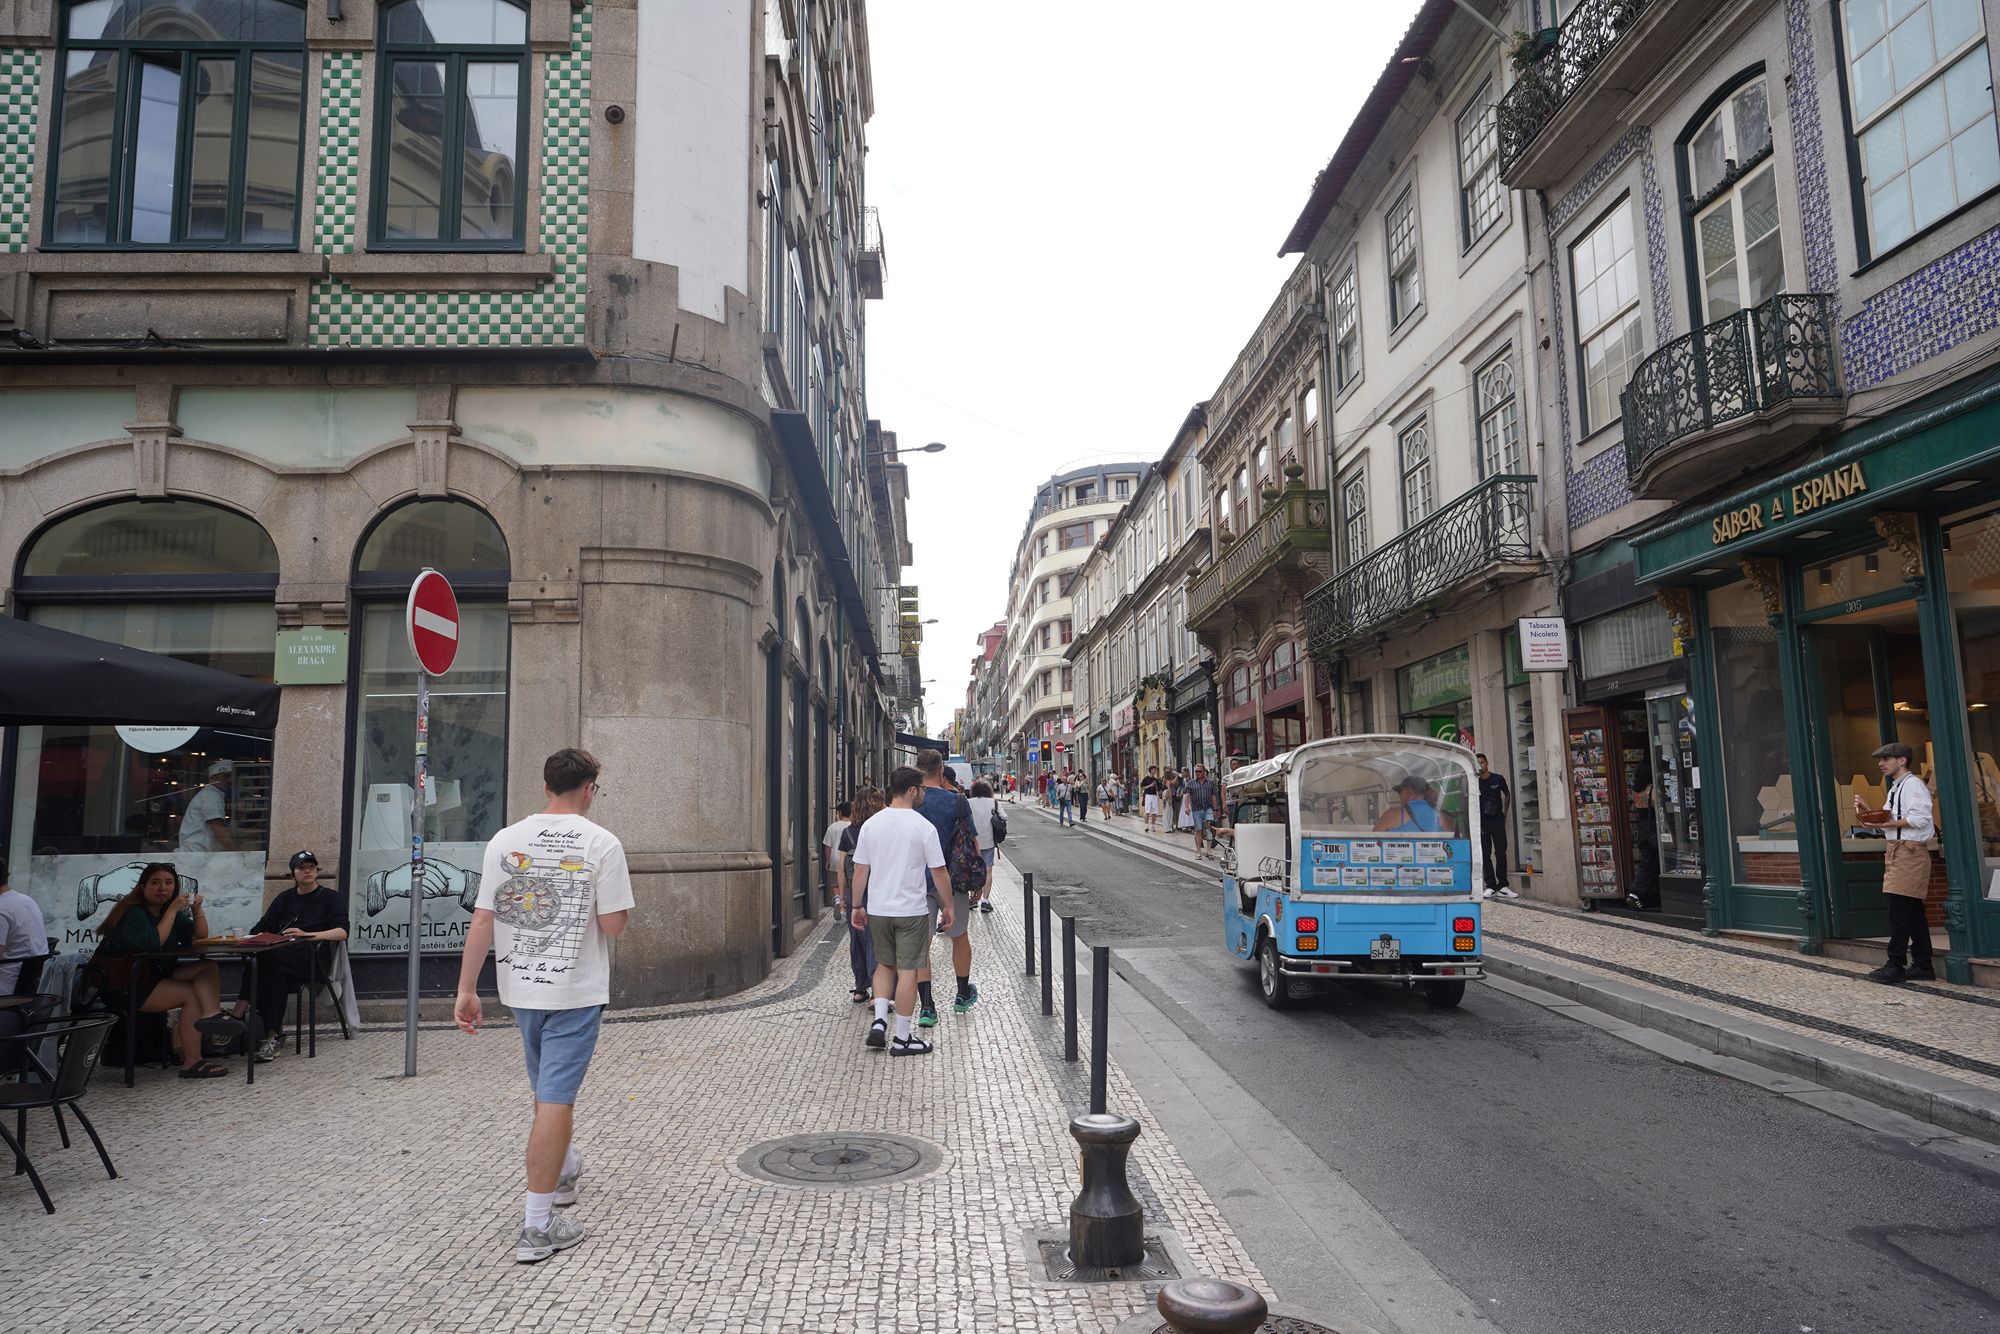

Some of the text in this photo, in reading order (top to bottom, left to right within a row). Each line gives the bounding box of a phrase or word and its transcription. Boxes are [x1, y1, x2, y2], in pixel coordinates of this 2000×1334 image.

[1712, 462, 1868, 545] SABOR A ESPAÑA
[1846, 600, 1862, 613] 305
[902, 587, 918, 656] NELMA
[288, 645, 336, 654] ALEXANDRE
[297, 657, 325, 665] BRAGA
[1325, 845, 1340, 853] TUK
[358, 922, 471, 939] MANTIGA
[421, 941, 446, 949] astéis
[1380, 941, 1391, 949] 09
